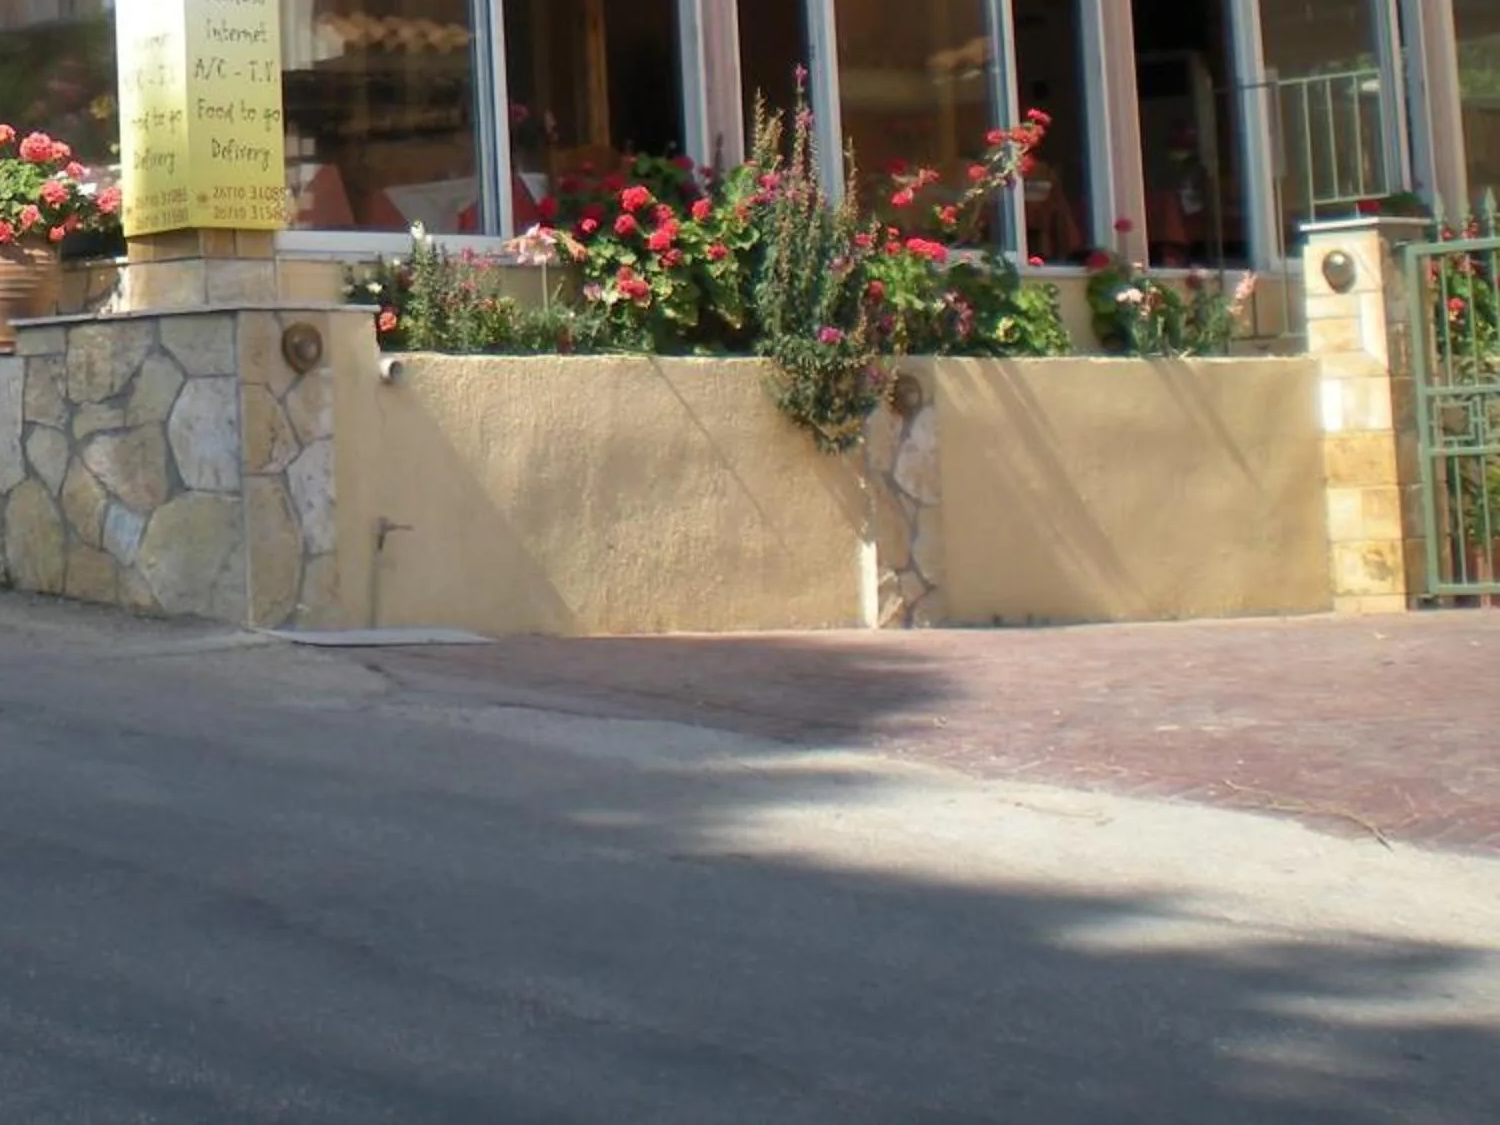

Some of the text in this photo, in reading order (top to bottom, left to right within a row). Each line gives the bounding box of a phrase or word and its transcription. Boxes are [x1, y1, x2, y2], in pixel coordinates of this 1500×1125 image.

[197, 98, 236, 125] Food
[241, 98, 257, 123] to
[211, 138, 270, 172] Delivery
